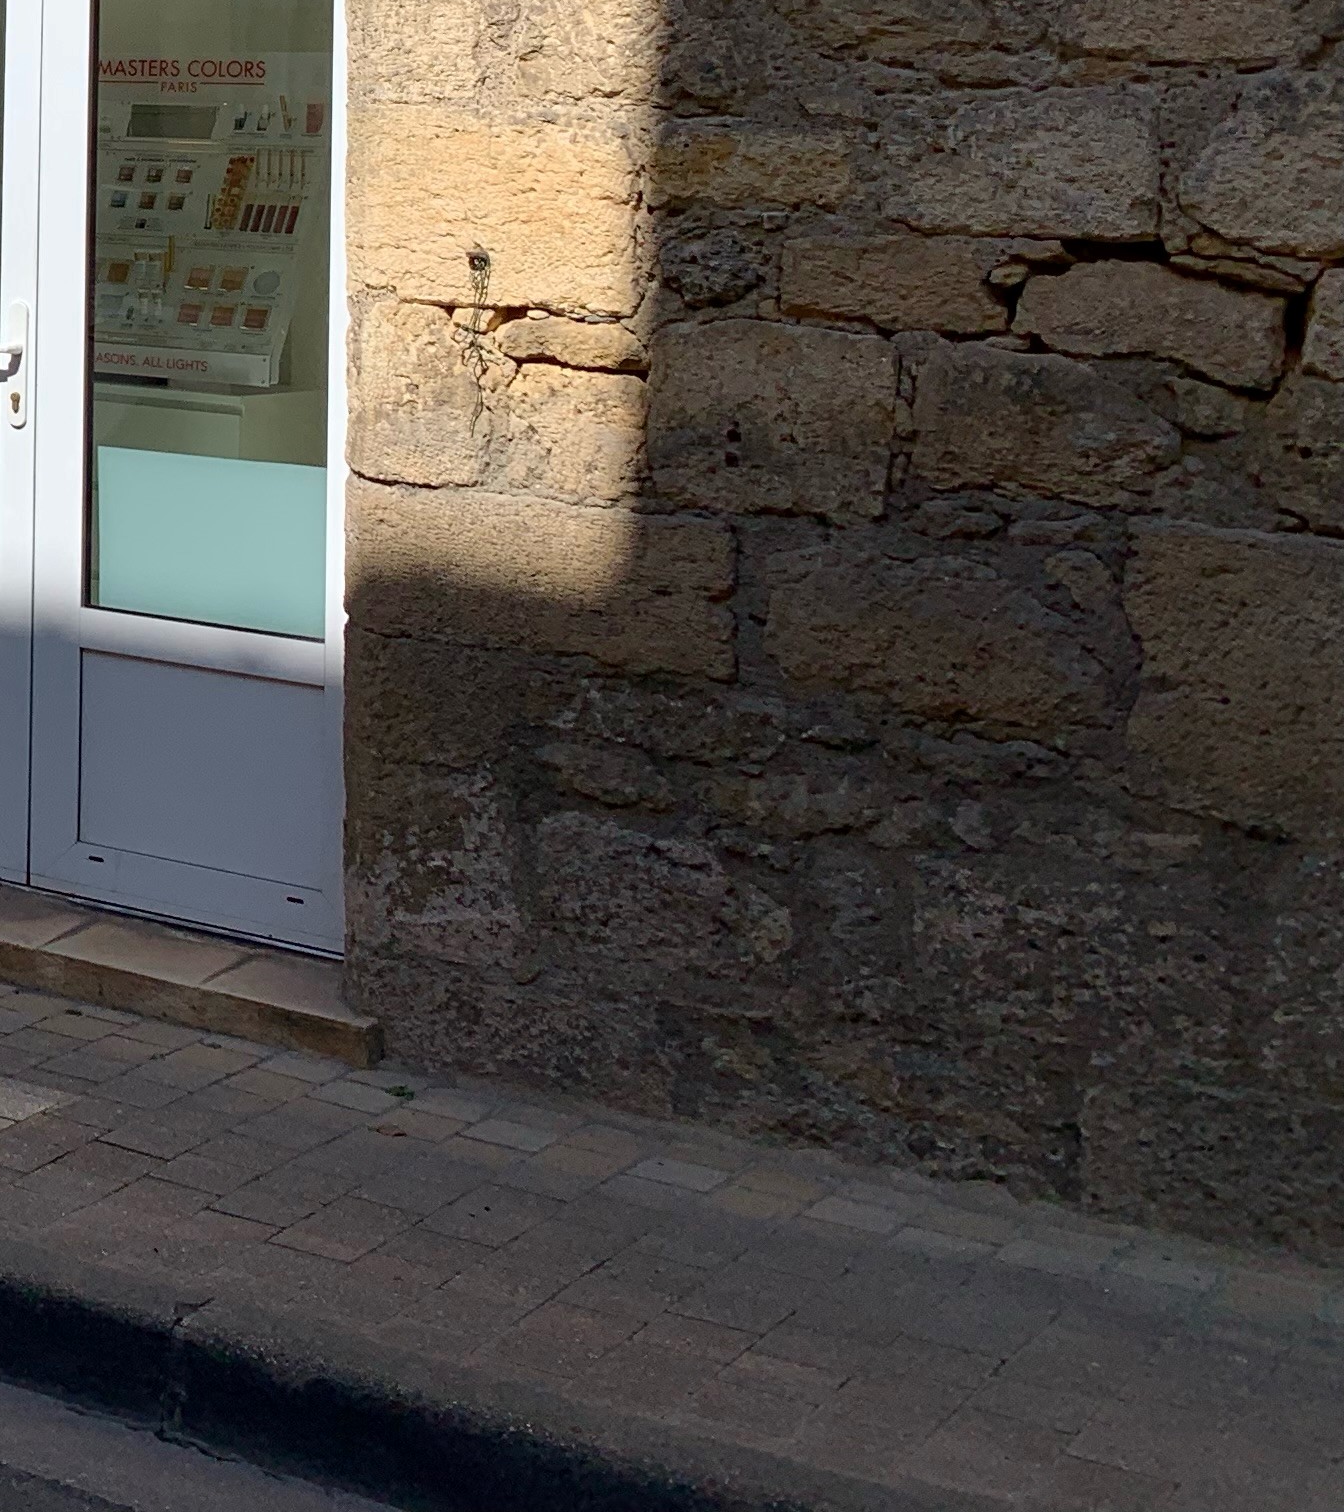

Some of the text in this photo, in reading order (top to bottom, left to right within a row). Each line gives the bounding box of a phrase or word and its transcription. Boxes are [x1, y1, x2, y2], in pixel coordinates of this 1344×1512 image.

[99, 59, 266, 79] MASTERS COLORS
[160, 82, 198, 93] PARIS
[96, 352, 208, 372] ASONS. ALL LIGHTS
